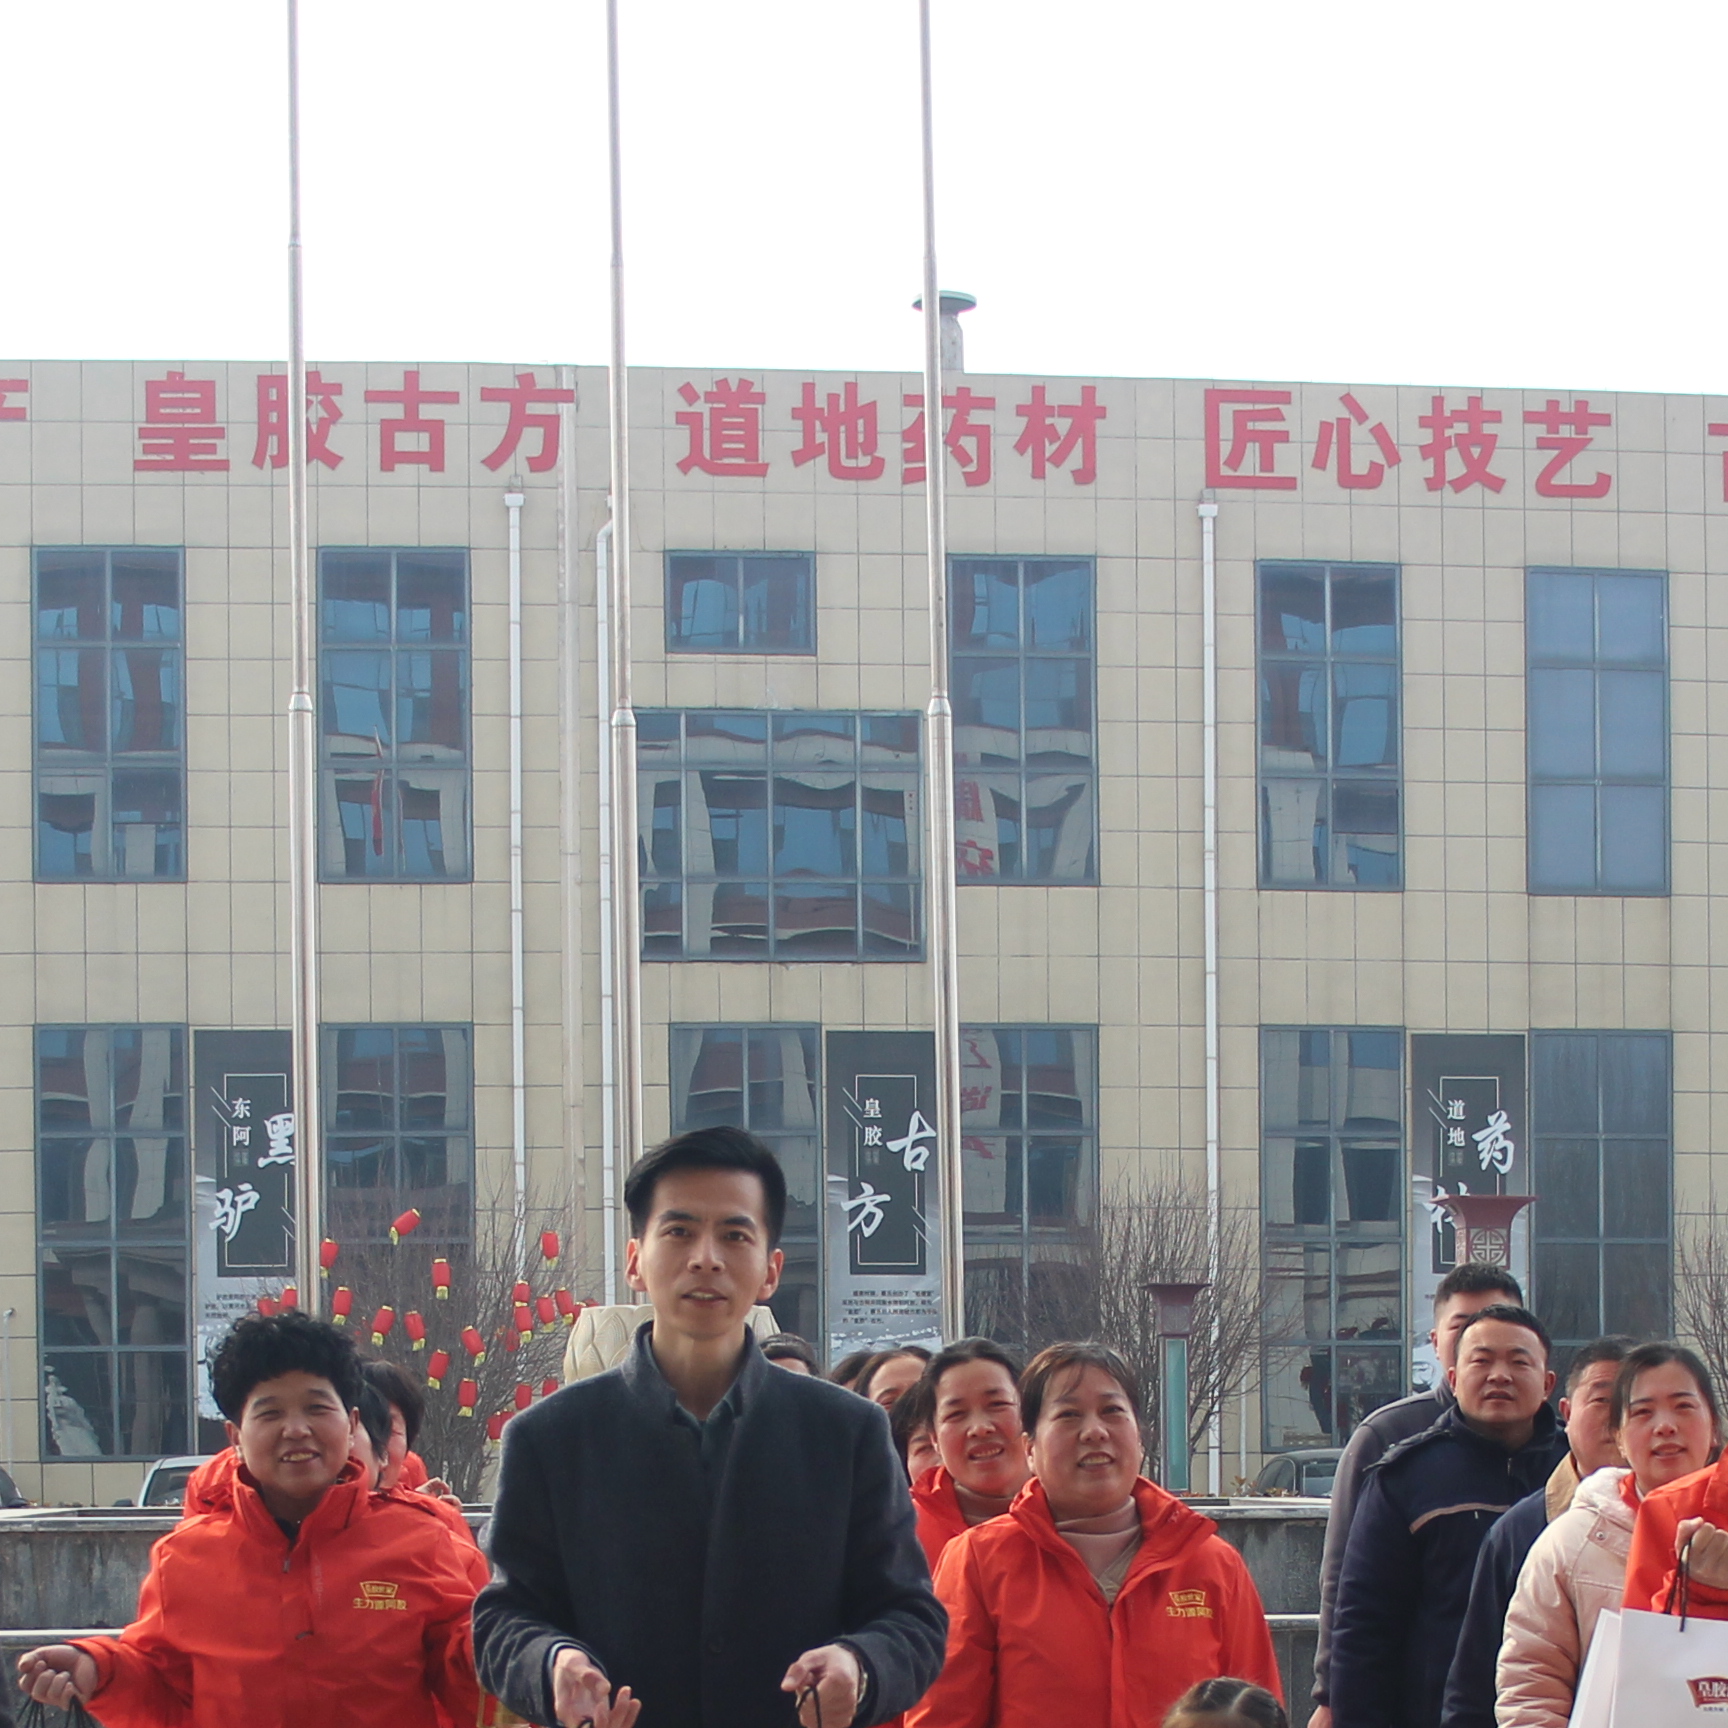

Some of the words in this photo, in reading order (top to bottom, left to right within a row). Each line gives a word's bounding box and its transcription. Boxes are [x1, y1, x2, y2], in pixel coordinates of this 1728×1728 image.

[133, 370, 576, 473] 皇胶古方
[674, 378, 1108, 487] 道地药材
[1203, 388, 1613, 499] 匠心技艺
[231, 1097, 252, 1147] 东阿
[863, 1097, 883, 1147] 皇胶
[1446, 1099, 1466, 1147] 道地
